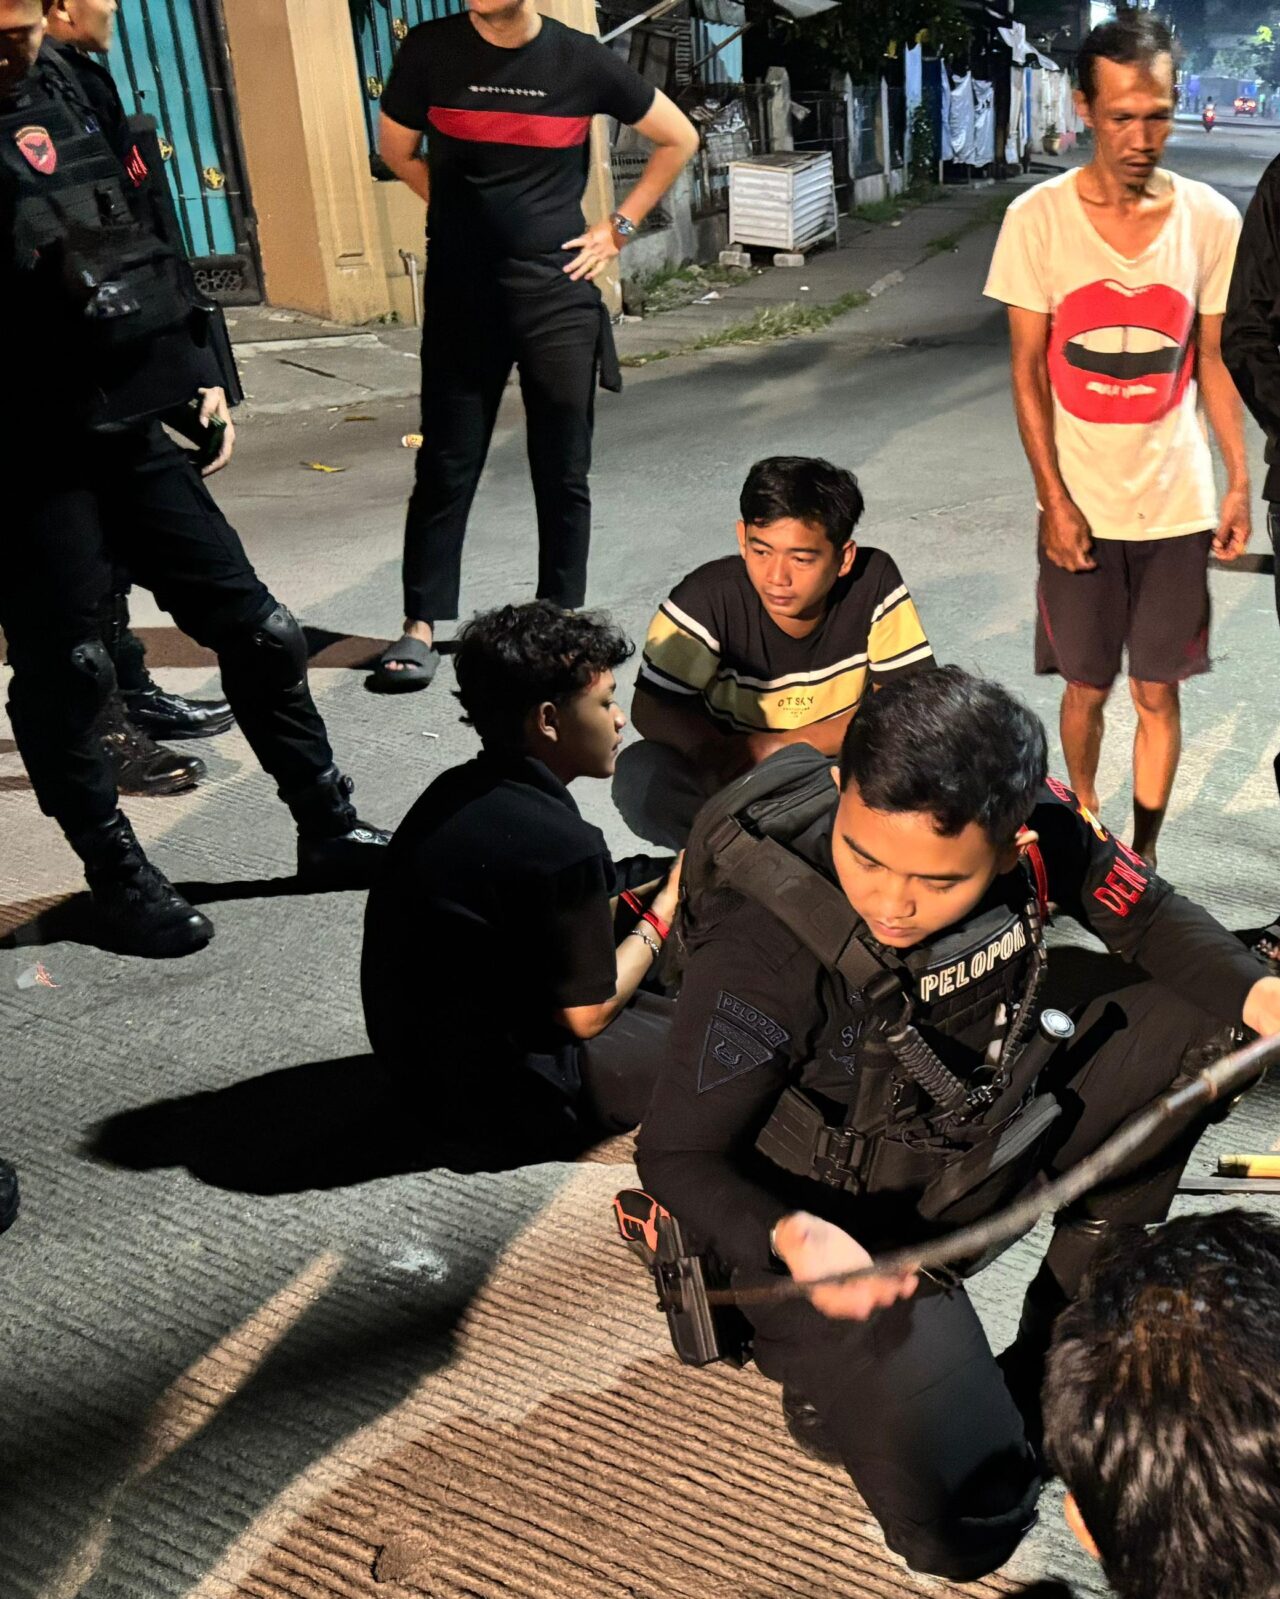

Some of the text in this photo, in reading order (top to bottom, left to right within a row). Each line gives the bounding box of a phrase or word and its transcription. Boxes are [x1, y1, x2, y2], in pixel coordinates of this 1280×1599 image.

[1092, 856, 1149, 917] DEN
[920, 920, 1027, 1003] PELOPOR
[722, 996, 784, 1044] PELOPOR
